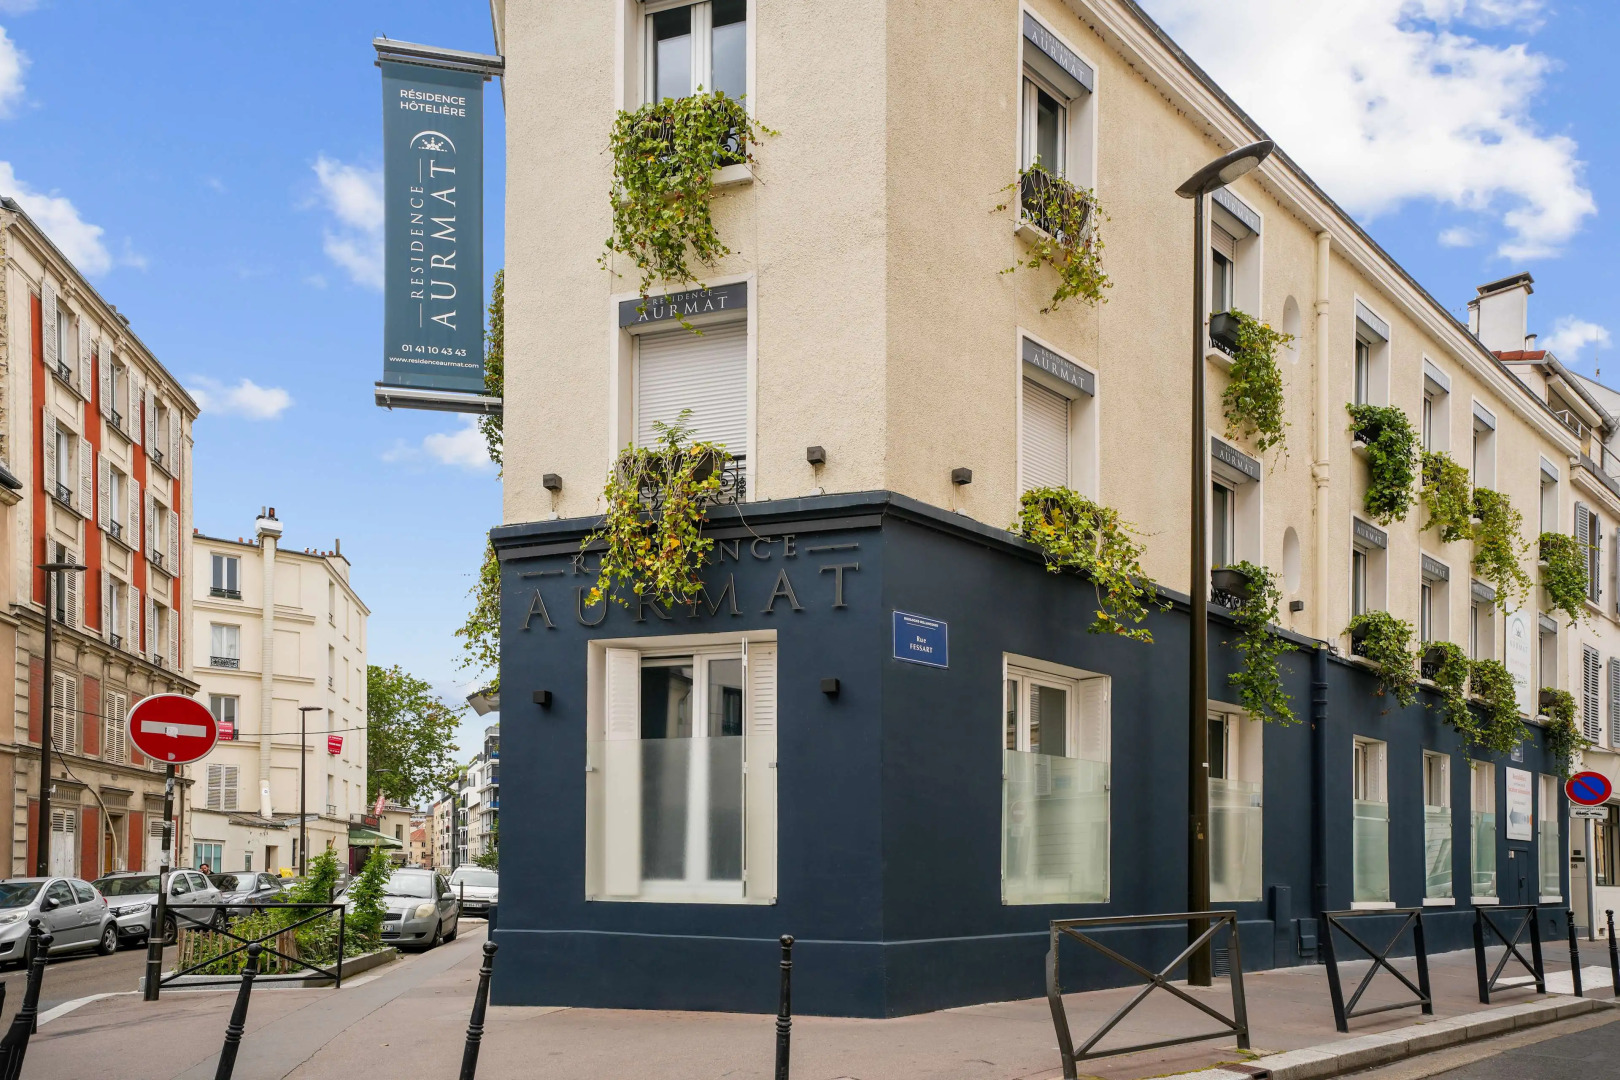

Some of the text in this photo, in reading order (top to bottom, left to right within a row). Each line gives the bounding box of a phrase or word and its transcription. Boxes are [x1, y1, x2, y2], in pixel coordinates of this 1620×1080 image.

[1031, 31, 1085, 81] AURMAT
[400, 89, 466, 106] RÉSIDENCE
[400, 101, 466, 117] HÔTELIÈRE
[410, 186, 424, 299] RESIDENCE
[430, 159, 457, 331] AURMAT
[652, 290, 713, 306] REIDENCE
[638, 296, 728, 322] AURMAT
[401, 344, 467, 357] 01 41 10 43 43
[388, 356, 480, 369] www.residenceaurmat.com
[1033, 353, 1085, 389] AURMAT
[1219, 449, 1254, 476] AURMAT
[909, 642, 933, 653] FESSART
[916, 635, 927, 644] Rue
